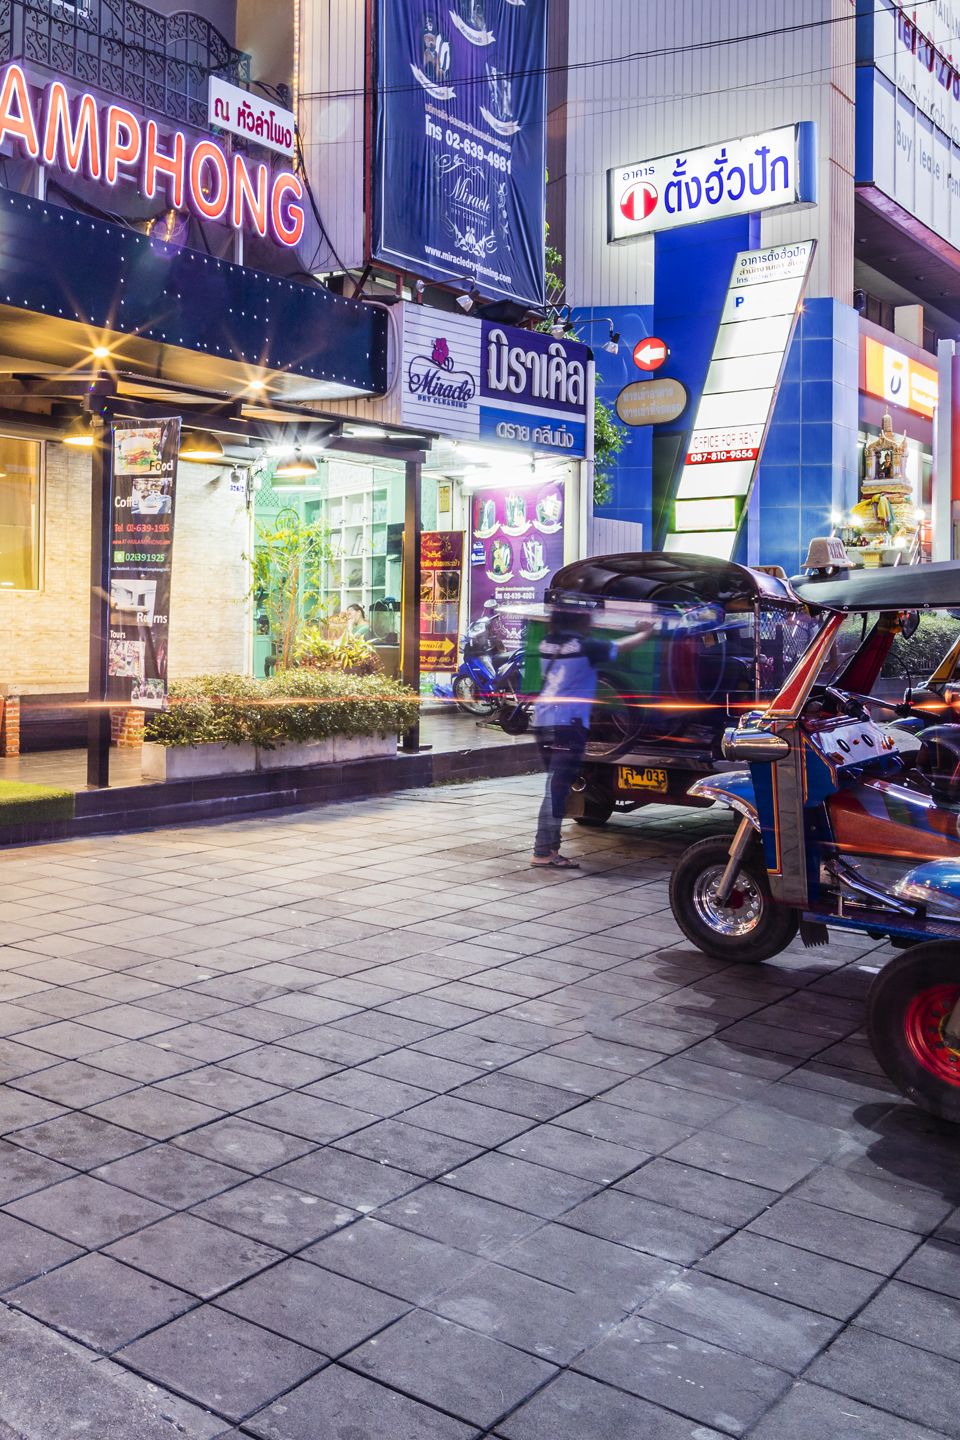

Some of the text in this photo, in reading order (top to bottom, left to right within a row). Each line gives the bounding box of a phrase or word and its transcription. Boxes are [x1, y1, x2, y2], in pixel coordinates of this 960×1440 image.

[215, 98, 292, 148] ณ หัวลำโพง
[425, 114, 512, 175] โทร 02-639-4981
[896, 120, 912, 162] Buy
[622, 165, 655, 181] อาคาร
[664, 145, 790, 215] ตั้งฮั่วปัก
[445, 175, 491, 214] Miracle
[424, 244, 512, 285] www.miracledrycleaning.com
[735, 296, 745, 308] P
[487, 328, 585, 405] มิราเคิล
[417, 393, 468, 409] DRY CLEANING
[496, 421, 575, 448] ดราย คลีนนิ่ง
[149, 460, 174, 471] Food
[110, 629, 126, 639] Tours
[136, 611, 168, 624] Roms
